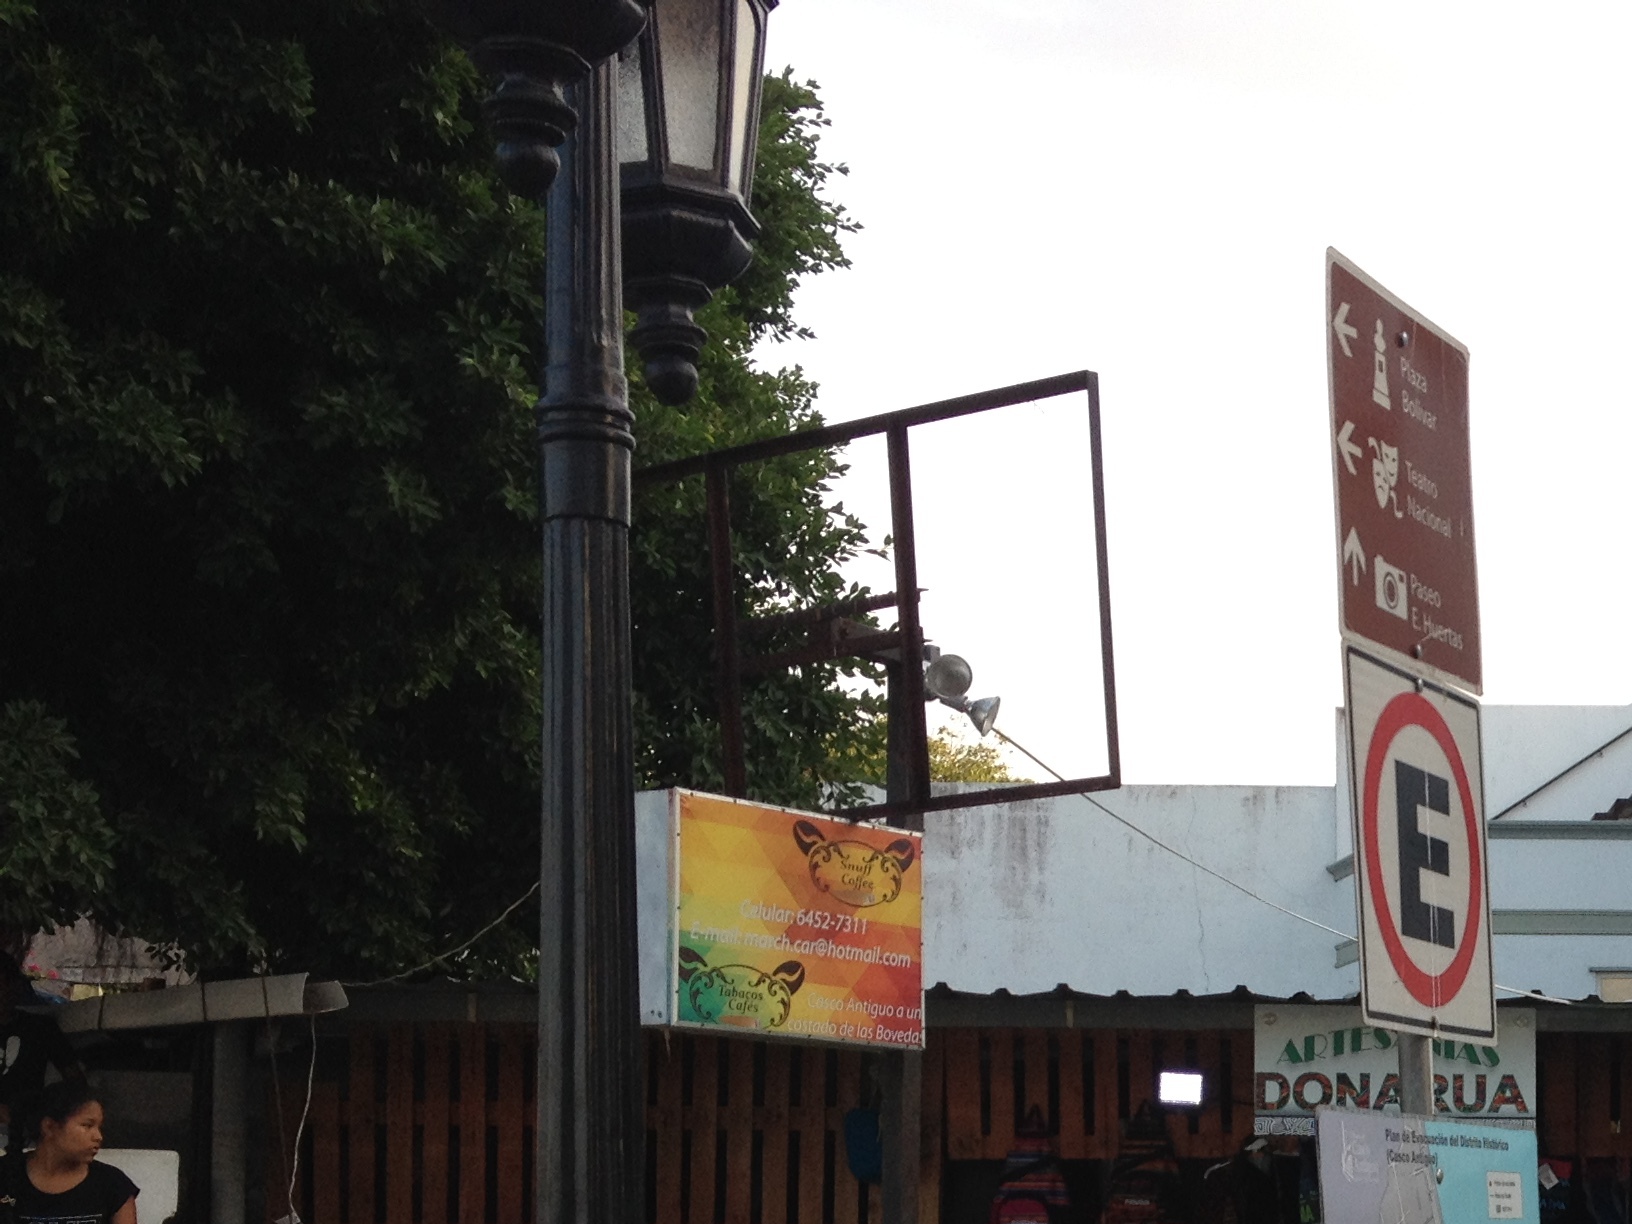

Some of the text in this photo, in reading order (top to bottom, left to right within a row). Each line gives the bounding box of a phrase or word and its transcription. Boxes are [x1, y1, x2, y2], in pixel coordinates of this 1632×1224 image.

[1400, 356, 1428, 393] Plaza
[1404, 460, 1439, 499] Teatro
[1406, 494, 1452, 538] Nacional
[1410, 573, 1442, 608] Paseo
[1423, 611, 1463, 650] Huertas
[840, 860, 872, 876] Snuff
[1394, 759, 1455, 950] E
[841, 873, 874, 890] Coffee
[796, 908, 868, 935] 6452-7311
[807, 992, 921, 1020] Casco Antiguo a un
[787, 1019, 837, 1035] costado
[839, 1021, 854, 1037] de
[856, 1021, 873, 1039] las
[1276, 1027, 1500, 1068] ARTESNIAS
[1450, 1135, 1459, 1147] del
